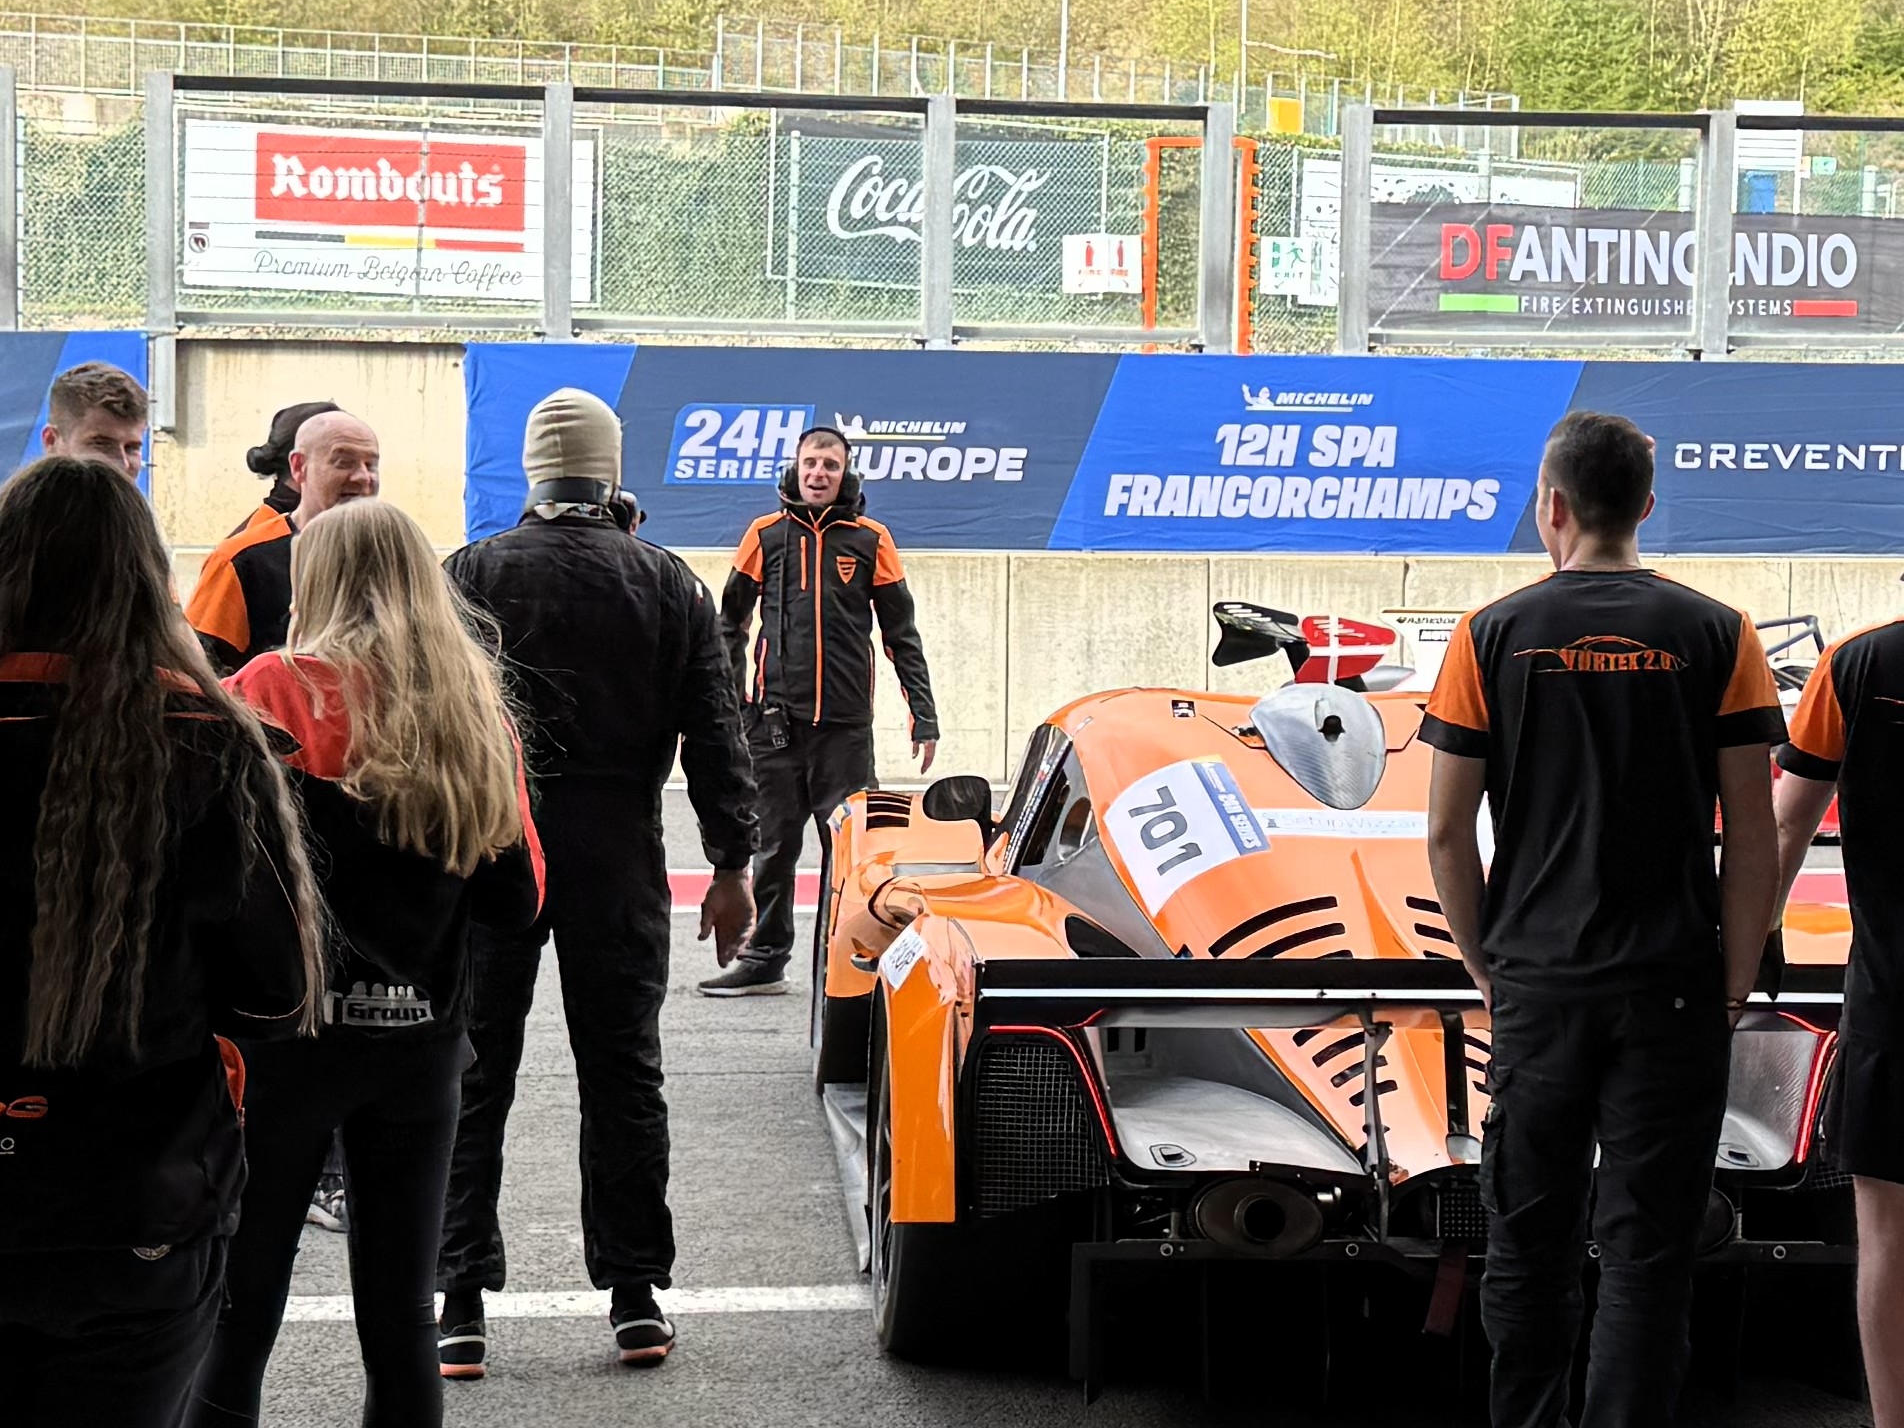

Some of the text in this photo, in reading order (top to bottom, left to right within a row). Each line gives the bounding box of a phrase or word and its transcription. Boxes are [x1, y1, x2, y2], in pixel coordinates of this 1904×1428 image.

[270, 153, 505, 207] Rombouts
[253, 249, 351, 276] Premium
[450, 259, 524, 292] Coffee
[1439, 223, 1858, 289] DFANTINCNDIO
[1520, 296, 1562, 313] FIRE
[1571, 297, 1695, 317] EXTINGUISHE
[1276, 392, 1374, 406] MICHELIN
[678, 409, 806, 459] 24H
[869, 420, 967, 435] MICHELIN
[1215, 424, 1398, 468] 12H SPA
[852, 446, 1028, 481] UROPE
[1103, 474, 1501, 521] FRANCORCHAMPS
[1128, 785, 1202, 876] 701
[346, 1002, 428, 1022] Group
